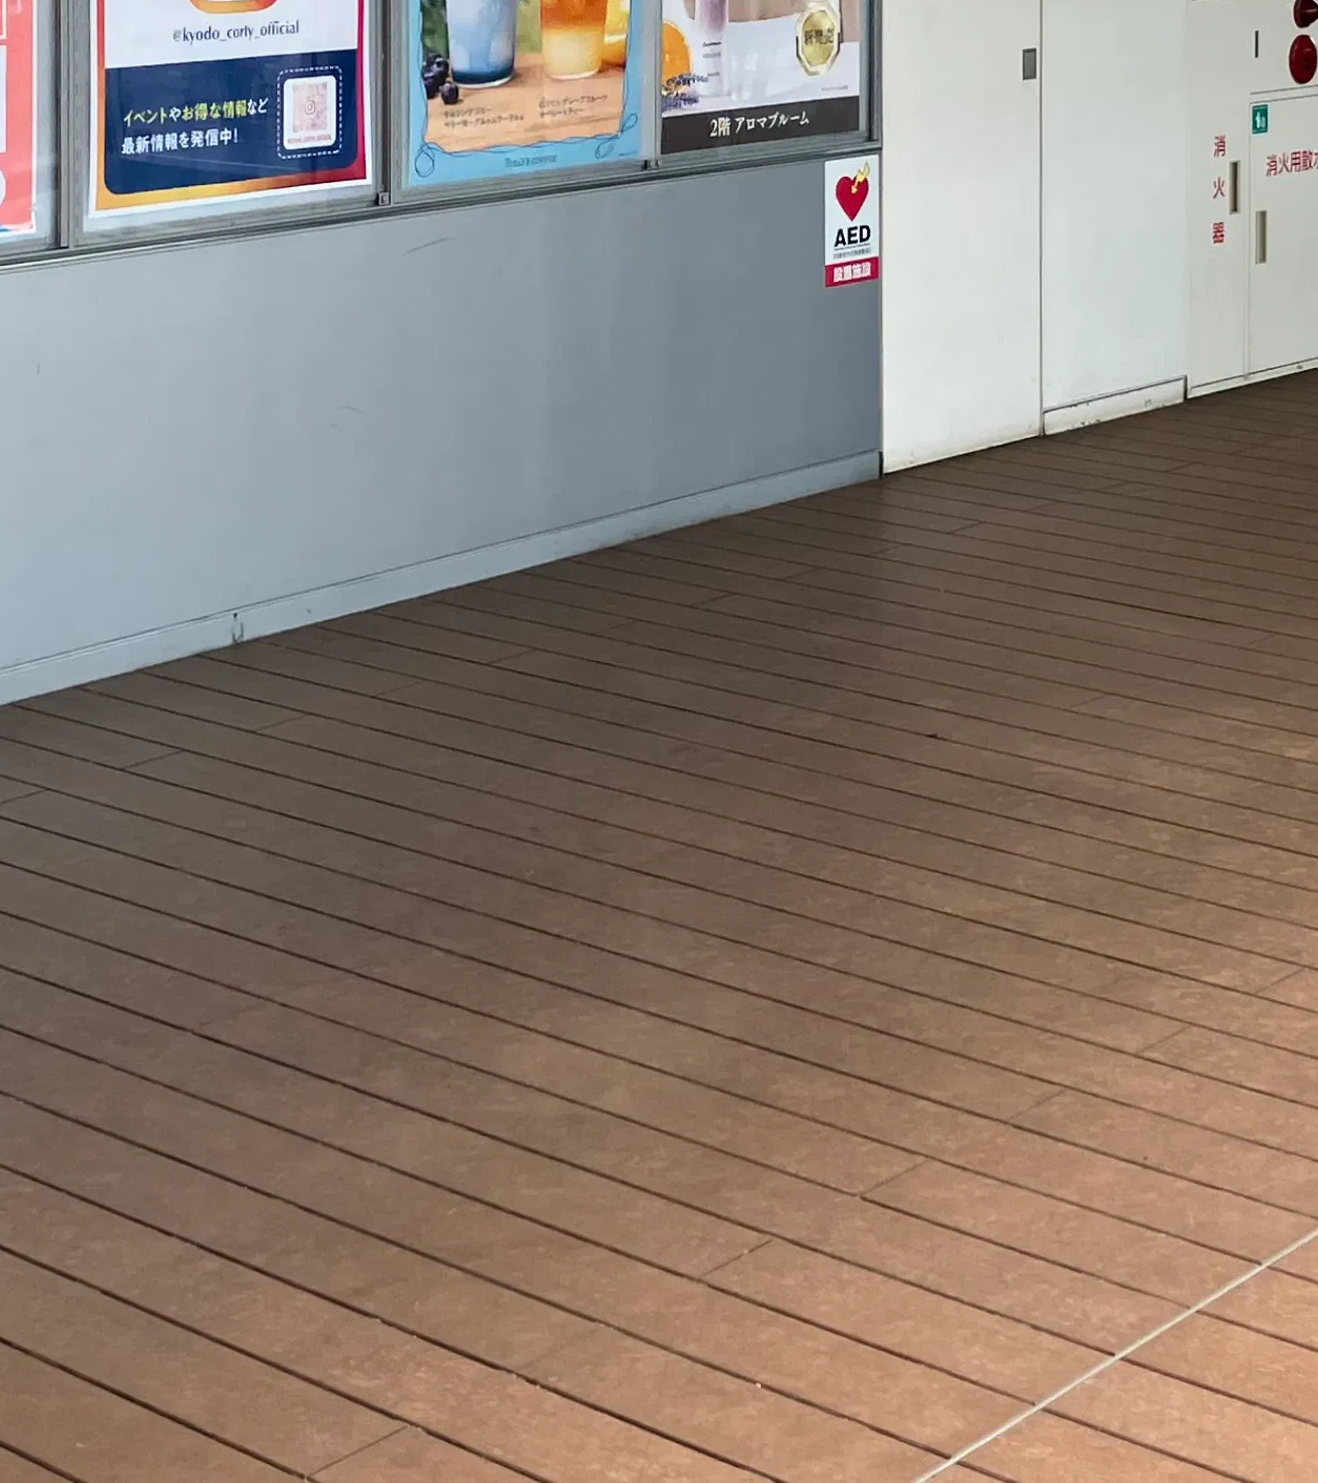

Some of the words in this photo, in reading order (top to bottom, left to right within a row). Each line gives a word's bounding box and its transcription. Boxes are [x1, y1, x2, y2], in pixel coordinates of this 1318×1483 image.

[172, 19, 301, 46] @kyodo_corty_official
[122, 96, 269, 128] イベントやお得な情報など
[709, 116, 732, 138] 2階
[734, 110, 811, 134] アロマブルーム
[120, 128, 239, 156] 最新情報を発信中!
[833, 224, 872, 248] AED
